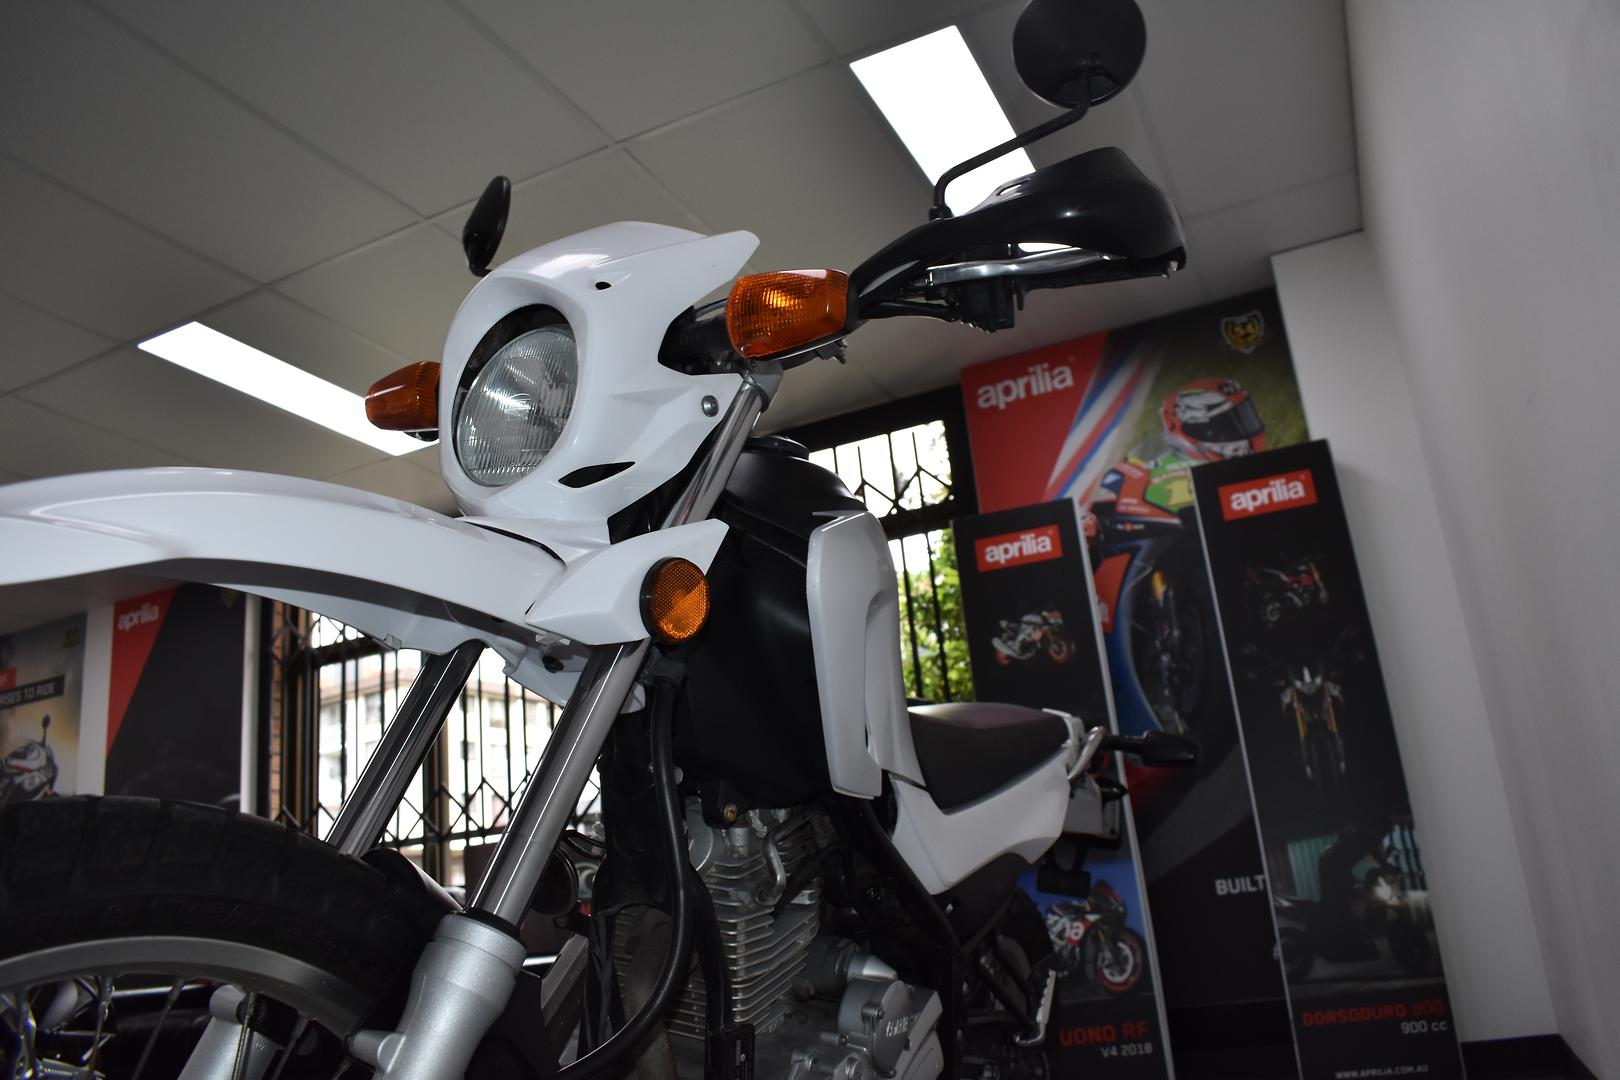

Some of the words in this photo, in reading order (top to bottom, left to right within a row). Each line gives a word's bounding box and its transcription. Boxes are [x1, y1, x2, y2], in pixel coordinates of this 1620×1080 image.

[976, 363, 1075, 410] aprilia
[1229, 475, 1305, 516] aprilia
[984, 532, 1053, 566] aprilia
[117, 604, 160, 631] aprilia
[24, 687, 35, 701] TO
[37, 682, 55, 699] RIDE
[1215, 874, 1266, 896] BUILT
[1301, 1003, 1408, 1028] DORSODURO
[1121, 1019, 1149, 1041] RF
[1400, 1021, 1429, 1035] 900
[1430, 1020, 1449, 1033] cc
[1100, 1047, 1118, 1059] V4
[1120, 1042, 1153, 1057] 2018
